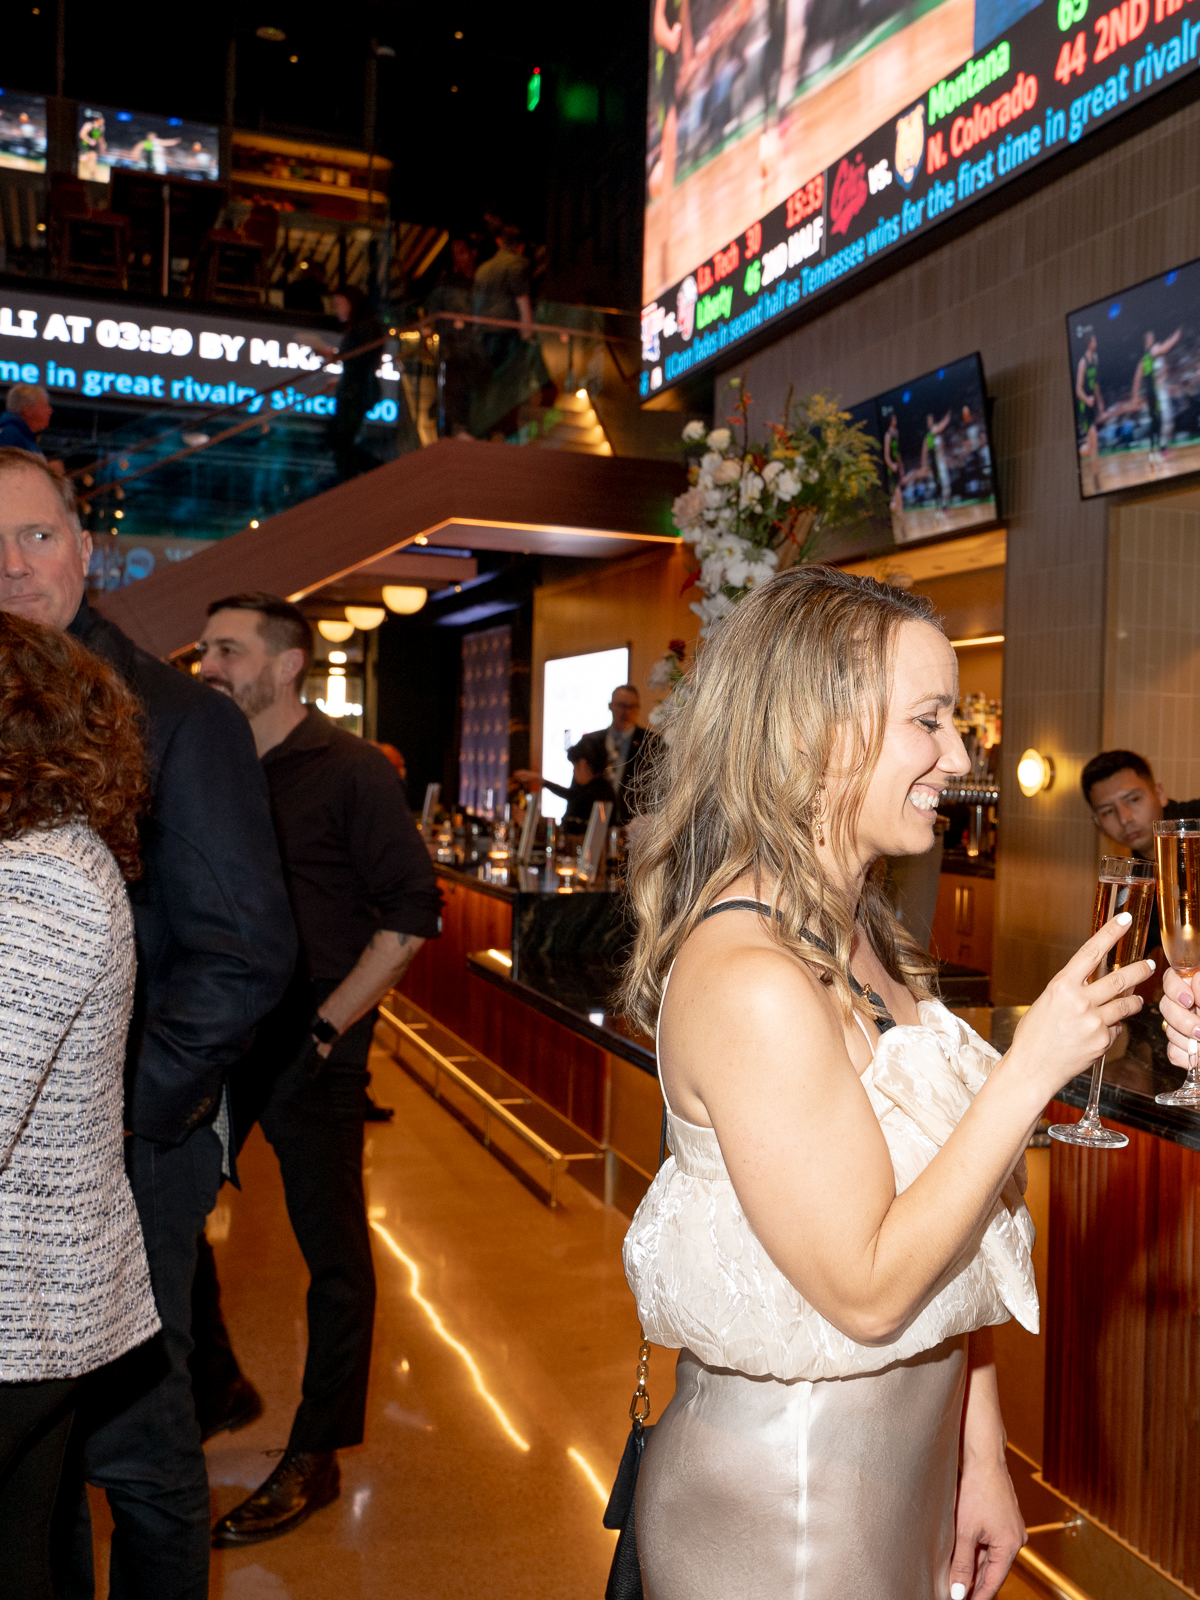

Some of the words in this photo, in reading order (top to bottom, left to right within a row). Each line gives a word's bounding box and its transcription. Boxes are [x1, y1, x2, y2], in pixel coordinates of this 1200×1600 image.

[926, 132, 948, 175] N.
[950, 72, 1038, 158] Colorado
[1054, 31, 1087, 85] 44
[1093, 0, 1150, 65] 2ND
[928, 41, 1010, 126] Montana
[665, 347, 693, 381] UConn
[718, 322, 729, 348] in
[728, 295, 763, 342] second
[763, 279, 787, 320] half
[785, 278, 800, 307] as
[801, 237, 865, 297] Tennessee
[865, 214, 900, 256] wins
[901, 196, 925, 235] for
[926, 179, 956, 219] the
[957, 150, 995, 200] first
[997, 124, 1041, 176] time
[1045, 107, 1066, 147] in
[1067, 64, 1130, 143] great
[868, 158, 892, 195] vs.
[696, 285, 733, 329] Liberty
[743, 259, 761, 296] 46
[761, 242, 788, 287] 2ND
[788, 216, 824, 268] HALF
[712, 241, 739, 282] Tech
[744, 222, 762, 259] 30
[786, 174, 824, 229] 15:33
[42, 313, 93, 344] AT
[95, 319, 194, 357] 03:59
[199, 331, 245, 362] BY
[46, 360, 77, 389] in
[81, 369, 165, 398] great
[171, 376, 265, 414] rivalry
